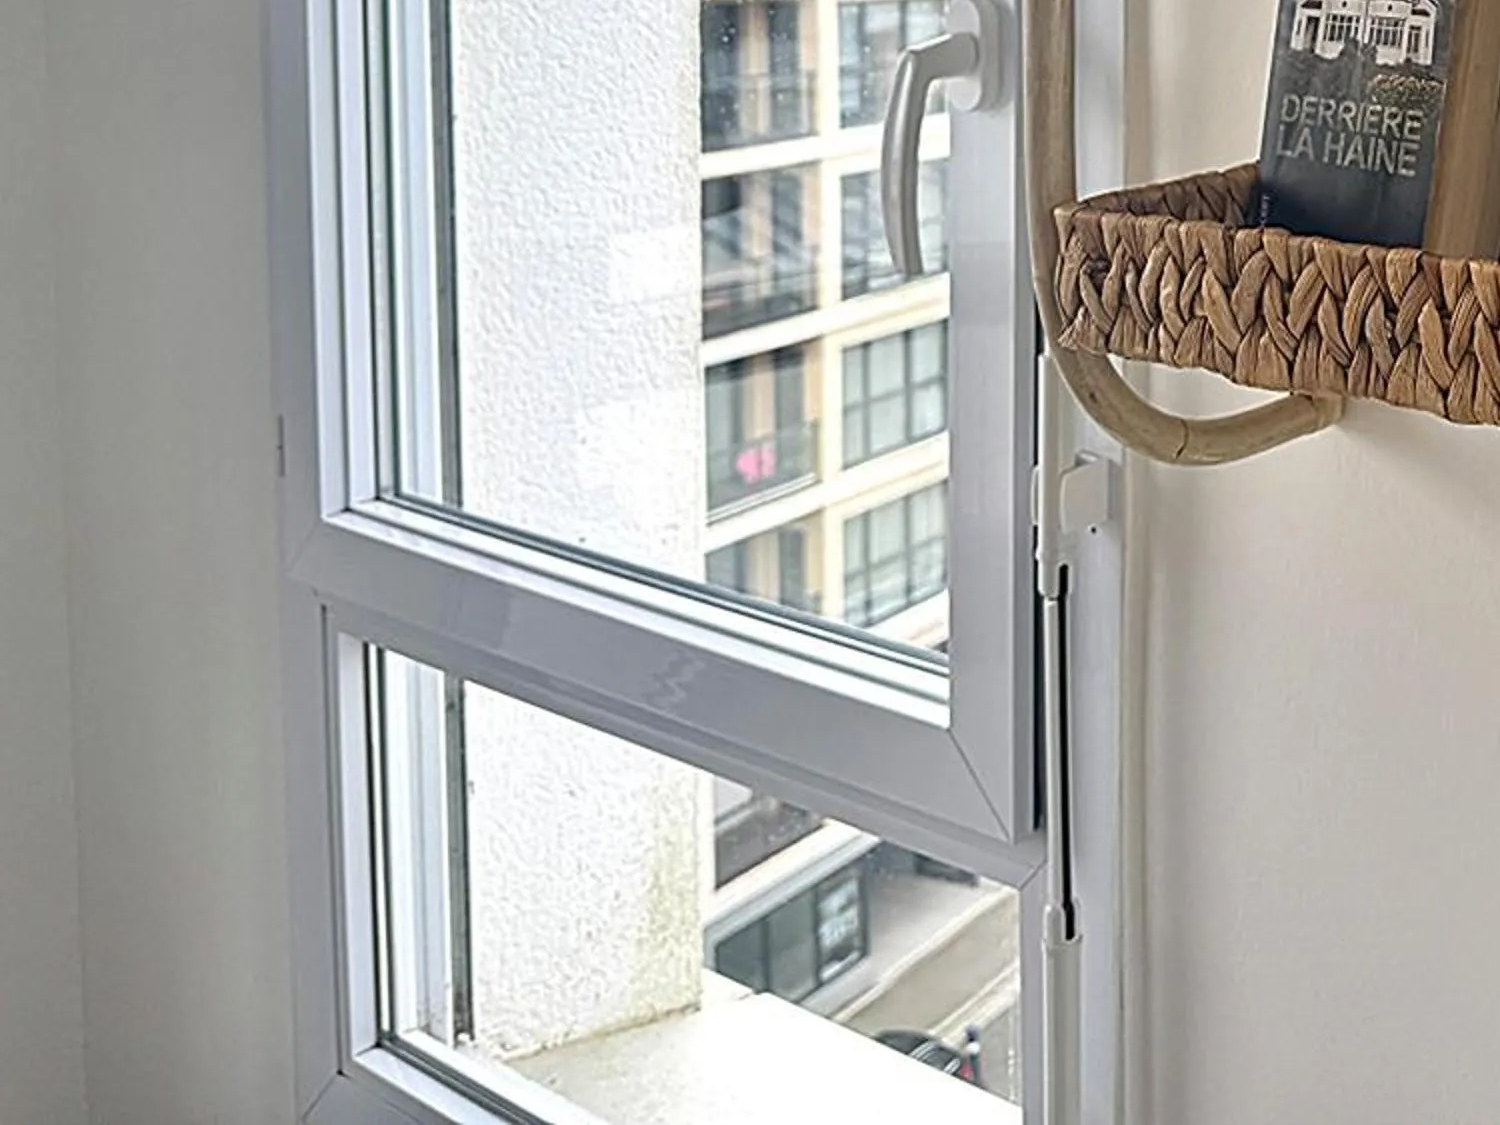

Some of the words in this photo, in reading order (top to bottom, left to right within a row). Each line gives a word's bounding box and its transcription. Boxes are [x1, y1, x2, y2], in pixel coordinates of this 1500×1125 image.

[1280, 92, 1424, 141] DERRIÈRE
[1277, 125, 1315, 162] LA
[1323, 131, 1421, 177] HAINE
